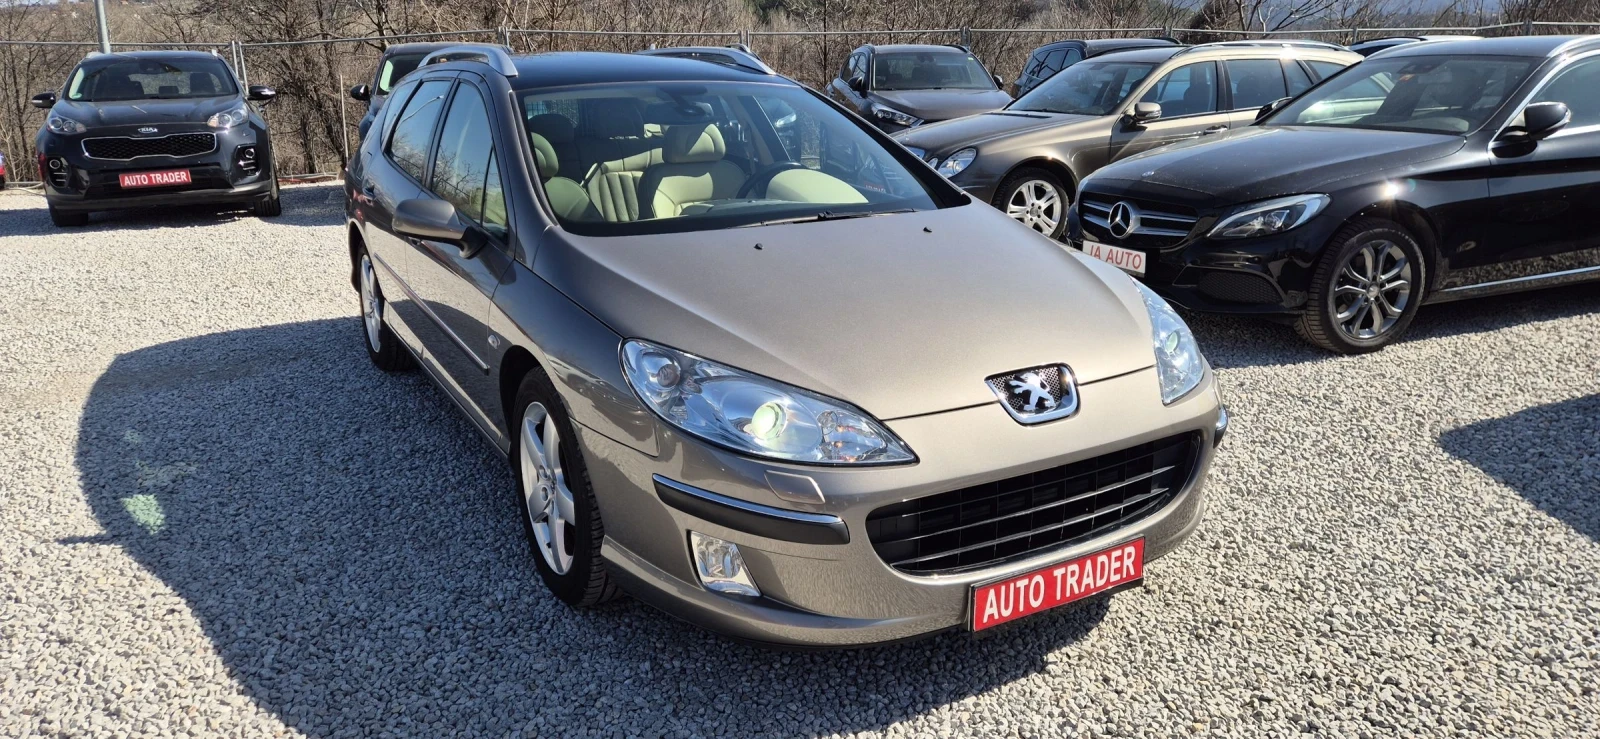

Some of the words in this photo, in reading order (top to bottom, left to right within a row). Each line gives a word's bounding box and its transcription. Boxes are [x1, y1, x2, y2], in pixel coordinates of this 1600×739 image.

[124, 174, 149, 186] AUTO
[150, 171, 188, 184] TRADER
[1105, 248, 1142, 269] AUTO
[983, 574, 1045, 624] AUTO
[1053, 545, 1136, 601] TRADER
